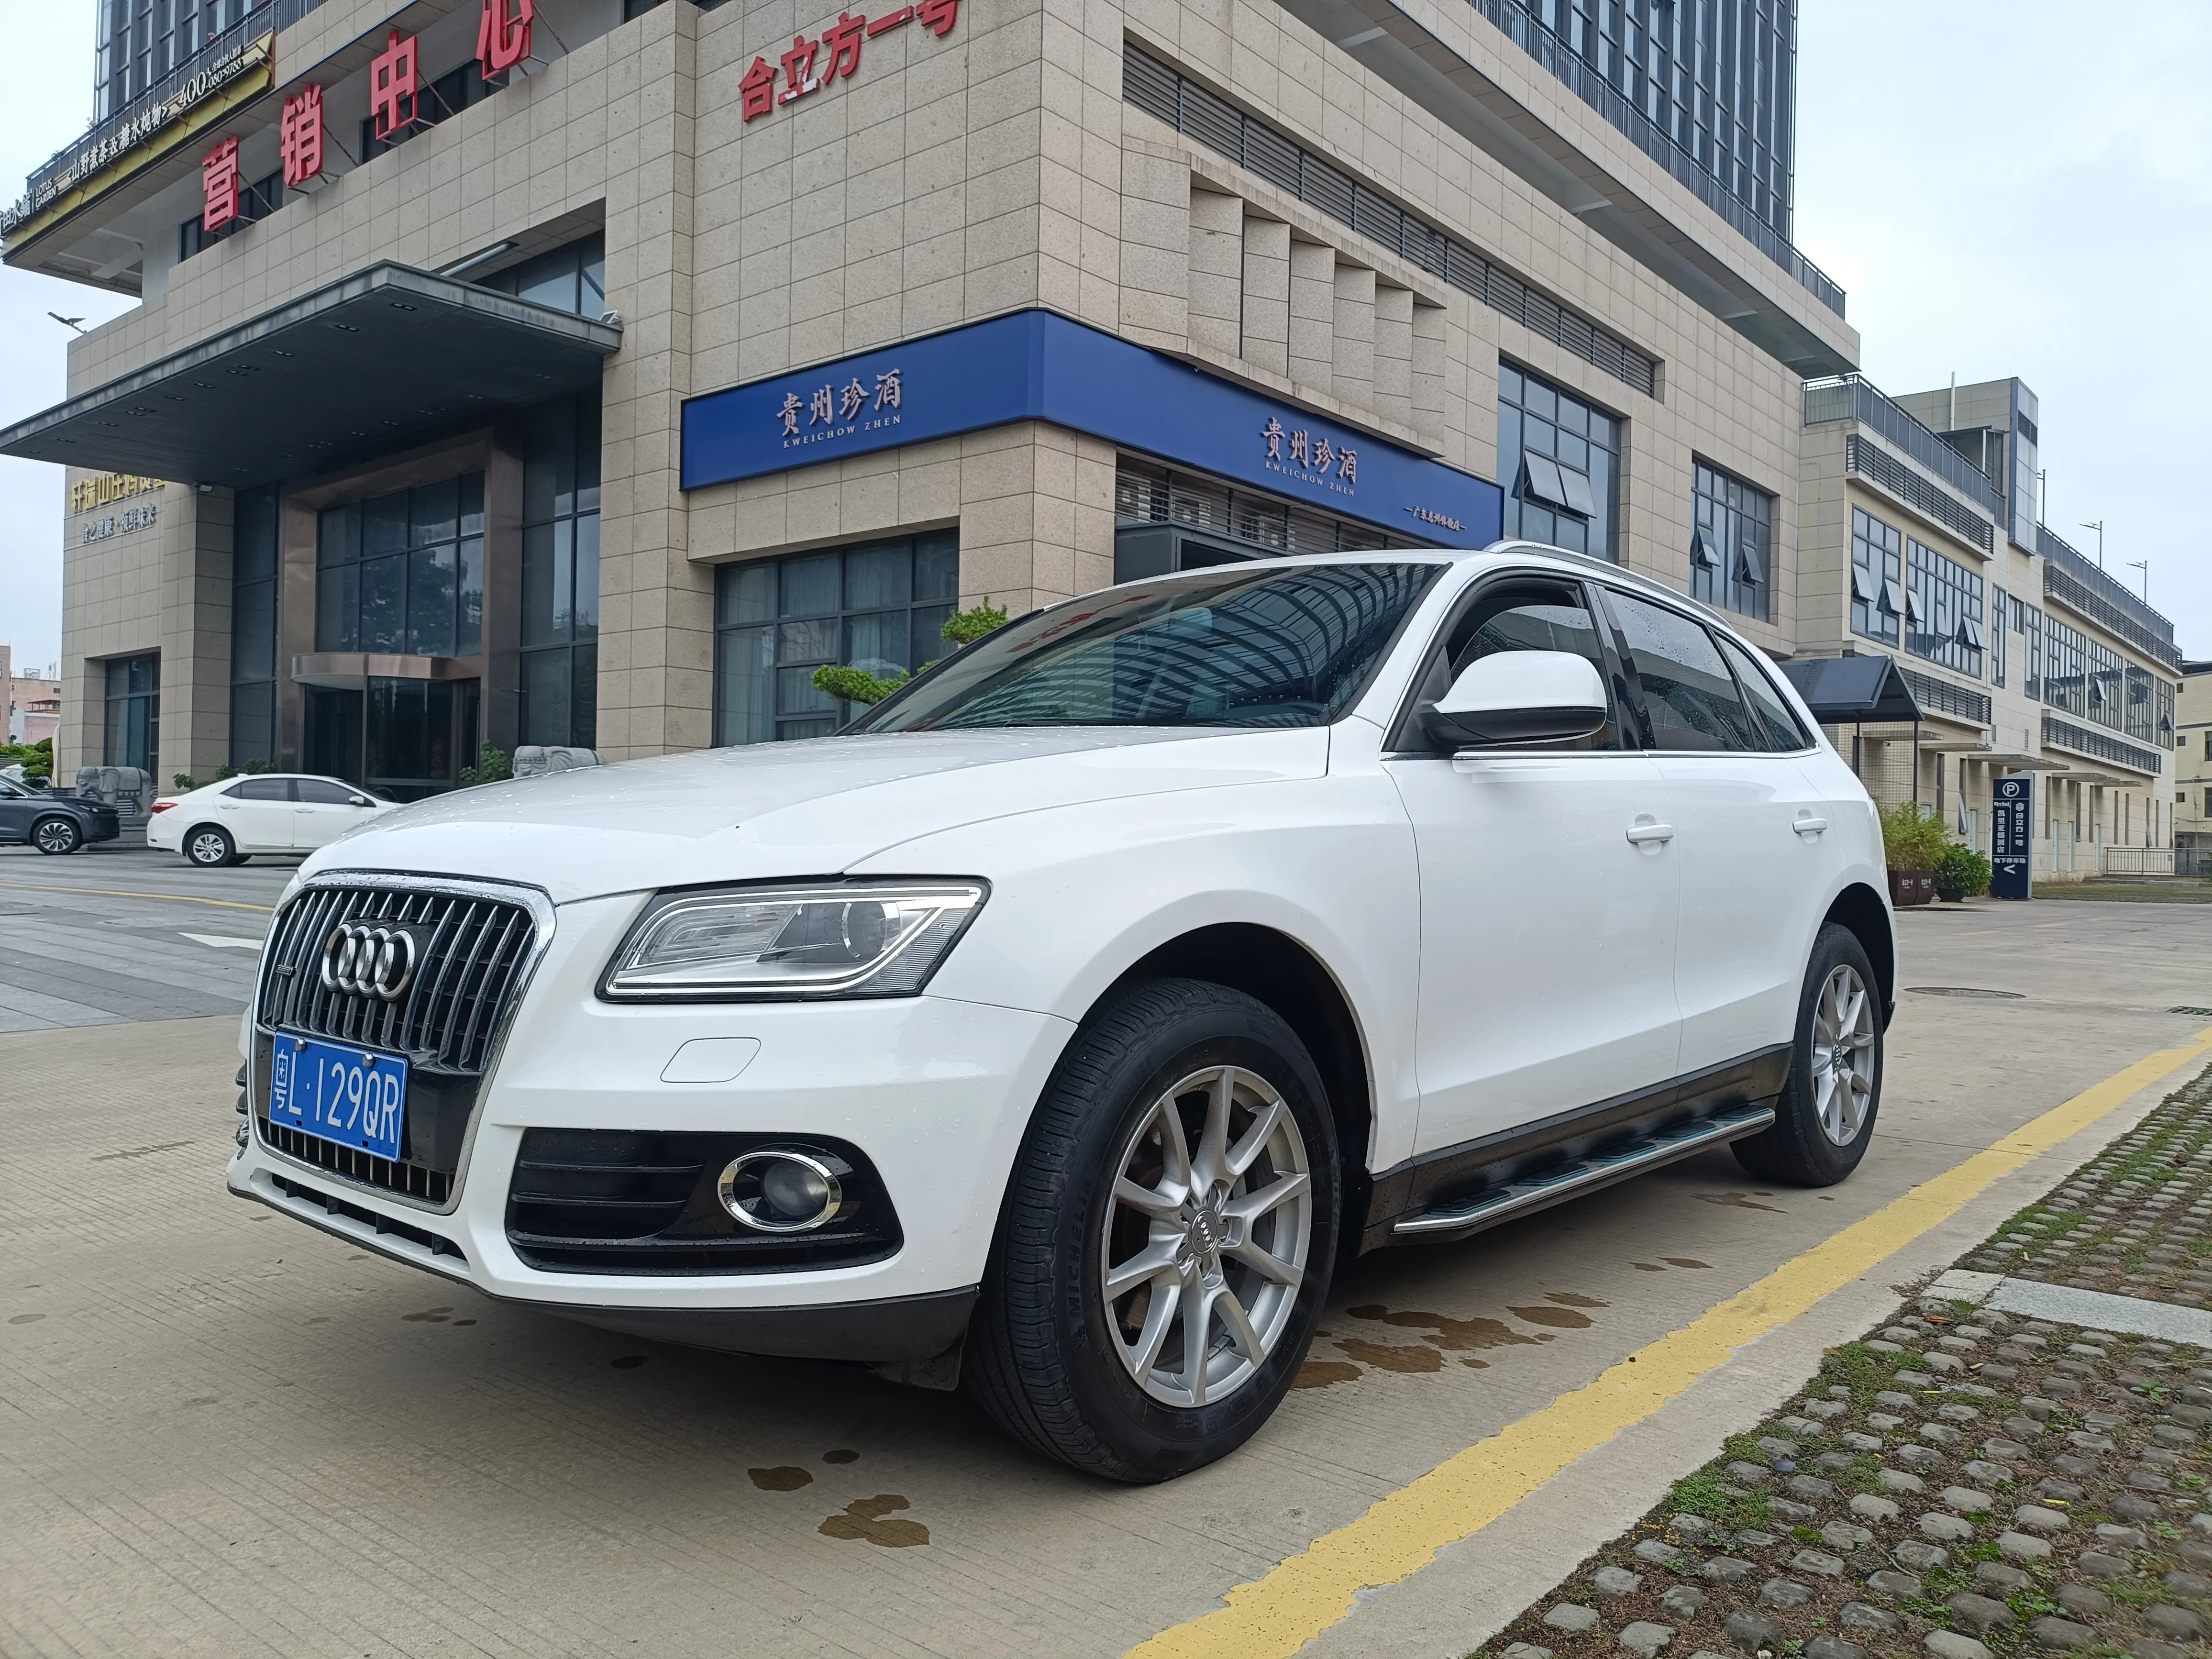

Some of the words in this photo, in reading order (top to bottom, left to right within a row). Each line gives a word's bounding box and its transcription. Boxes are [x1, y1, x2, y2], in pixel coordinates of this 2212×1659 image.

[35, 185, 57, 209] GARDEN
[36, 178, 52, 198] LOTUS
[776, 368, 901, 437] 贵州珍酒
[783, 425, 856, 449] KWEICHOW
[864, 415, 901, 431] ZHEN
[1262, 417, 1358, 485] 贵州珍酒
[1265, 461, 1324, 487] KWEICHOW
[1329, 482, 1355, 497] ZHEN
